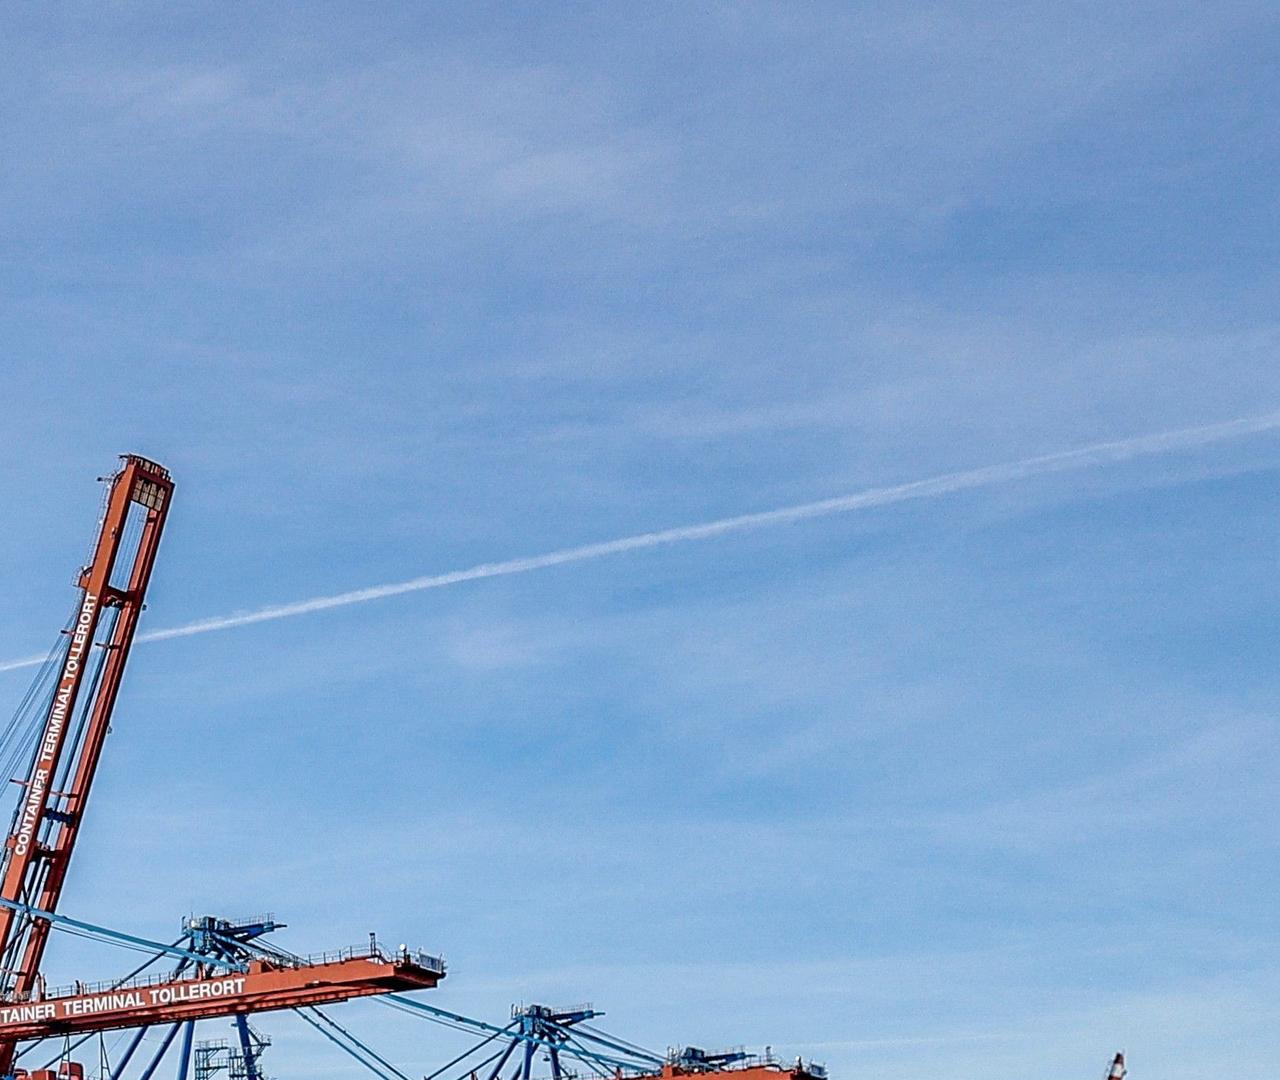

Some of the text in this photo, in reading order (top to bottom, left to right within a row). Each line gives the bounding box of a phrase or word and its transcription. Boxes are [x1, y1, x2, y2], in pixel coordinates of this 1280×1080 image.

[41, 685, 72, 762] TERMINAL
[63, 592, 97, 681] TOLLERORT
[63, 992, 145, 1016] TERMINAL
[150, 978, 245, 1003] TOLLERORT
